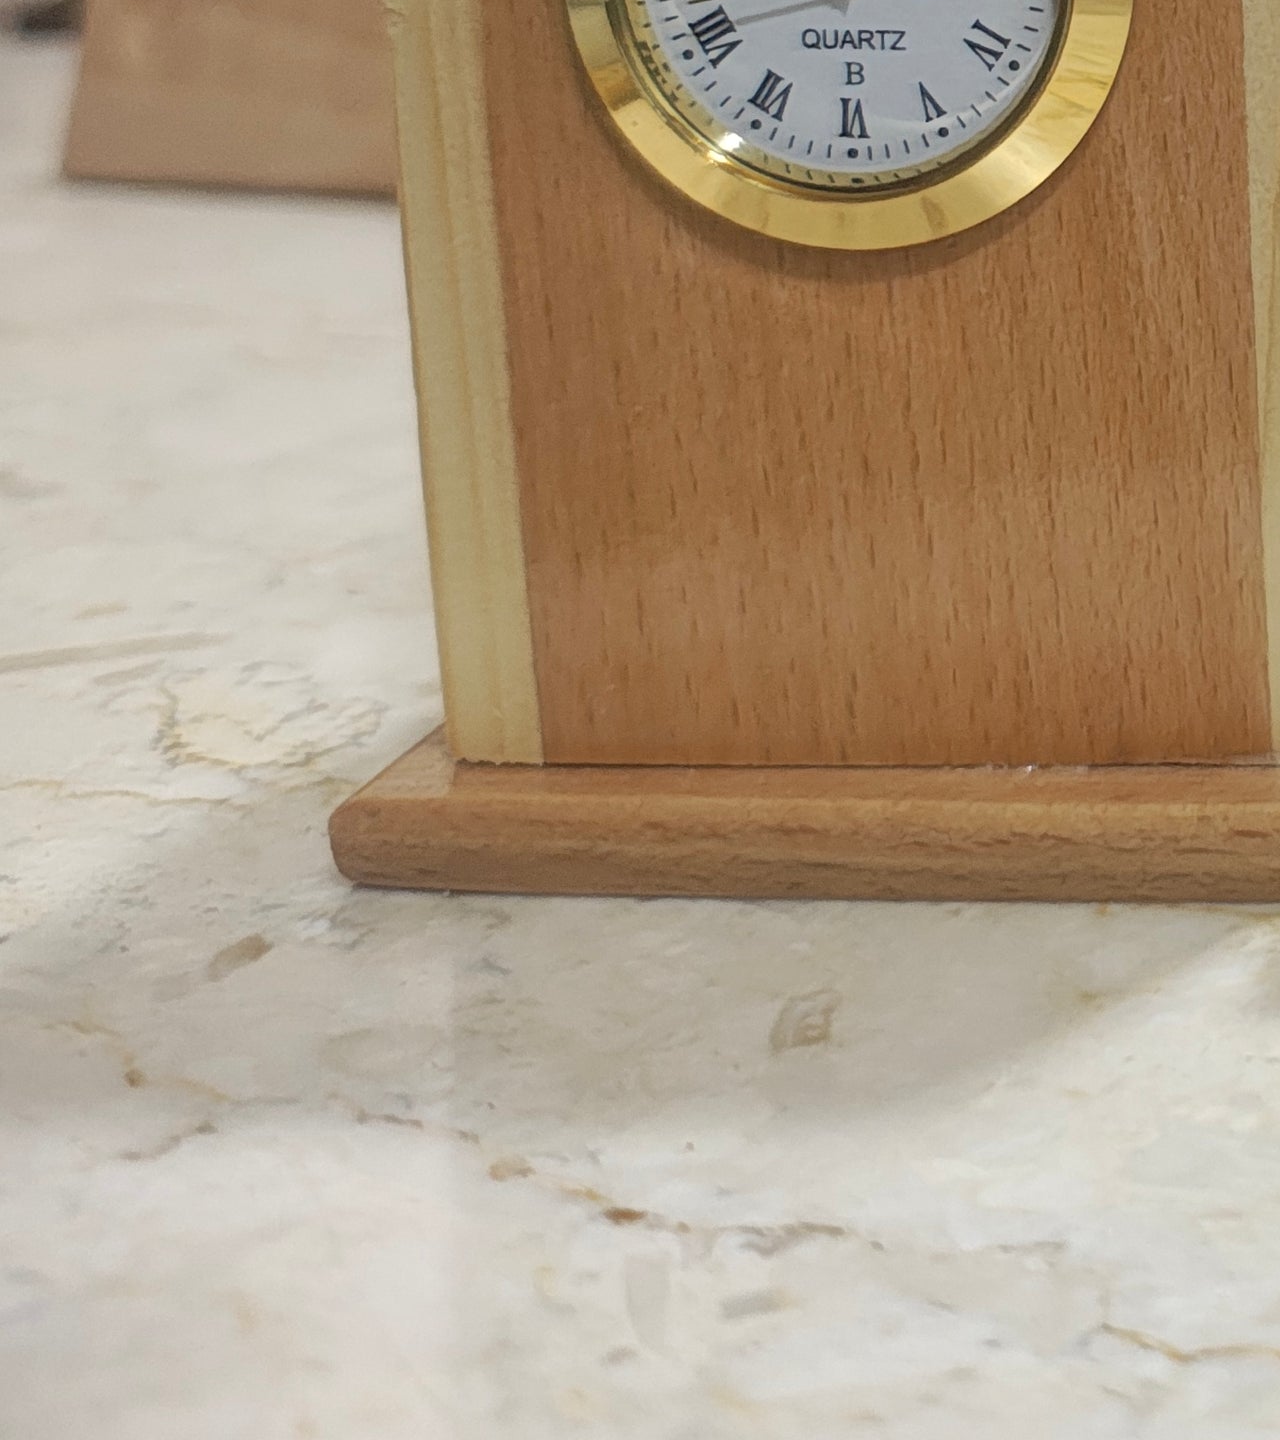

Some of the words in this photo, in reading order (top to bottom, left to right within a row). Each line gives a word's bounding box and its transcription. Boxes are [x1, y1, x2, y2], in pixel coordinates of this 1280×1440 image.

[687, 5, 743, 68] VIII
[802, 29, 906, 50] QUARTZ
[963, 19, 1011, 71] IV
[845, 62, 864, 85] B
[747, 69, 792, 123] VII
[919, 82, 947, 122] V
[838, 98, 870, 138] VI
